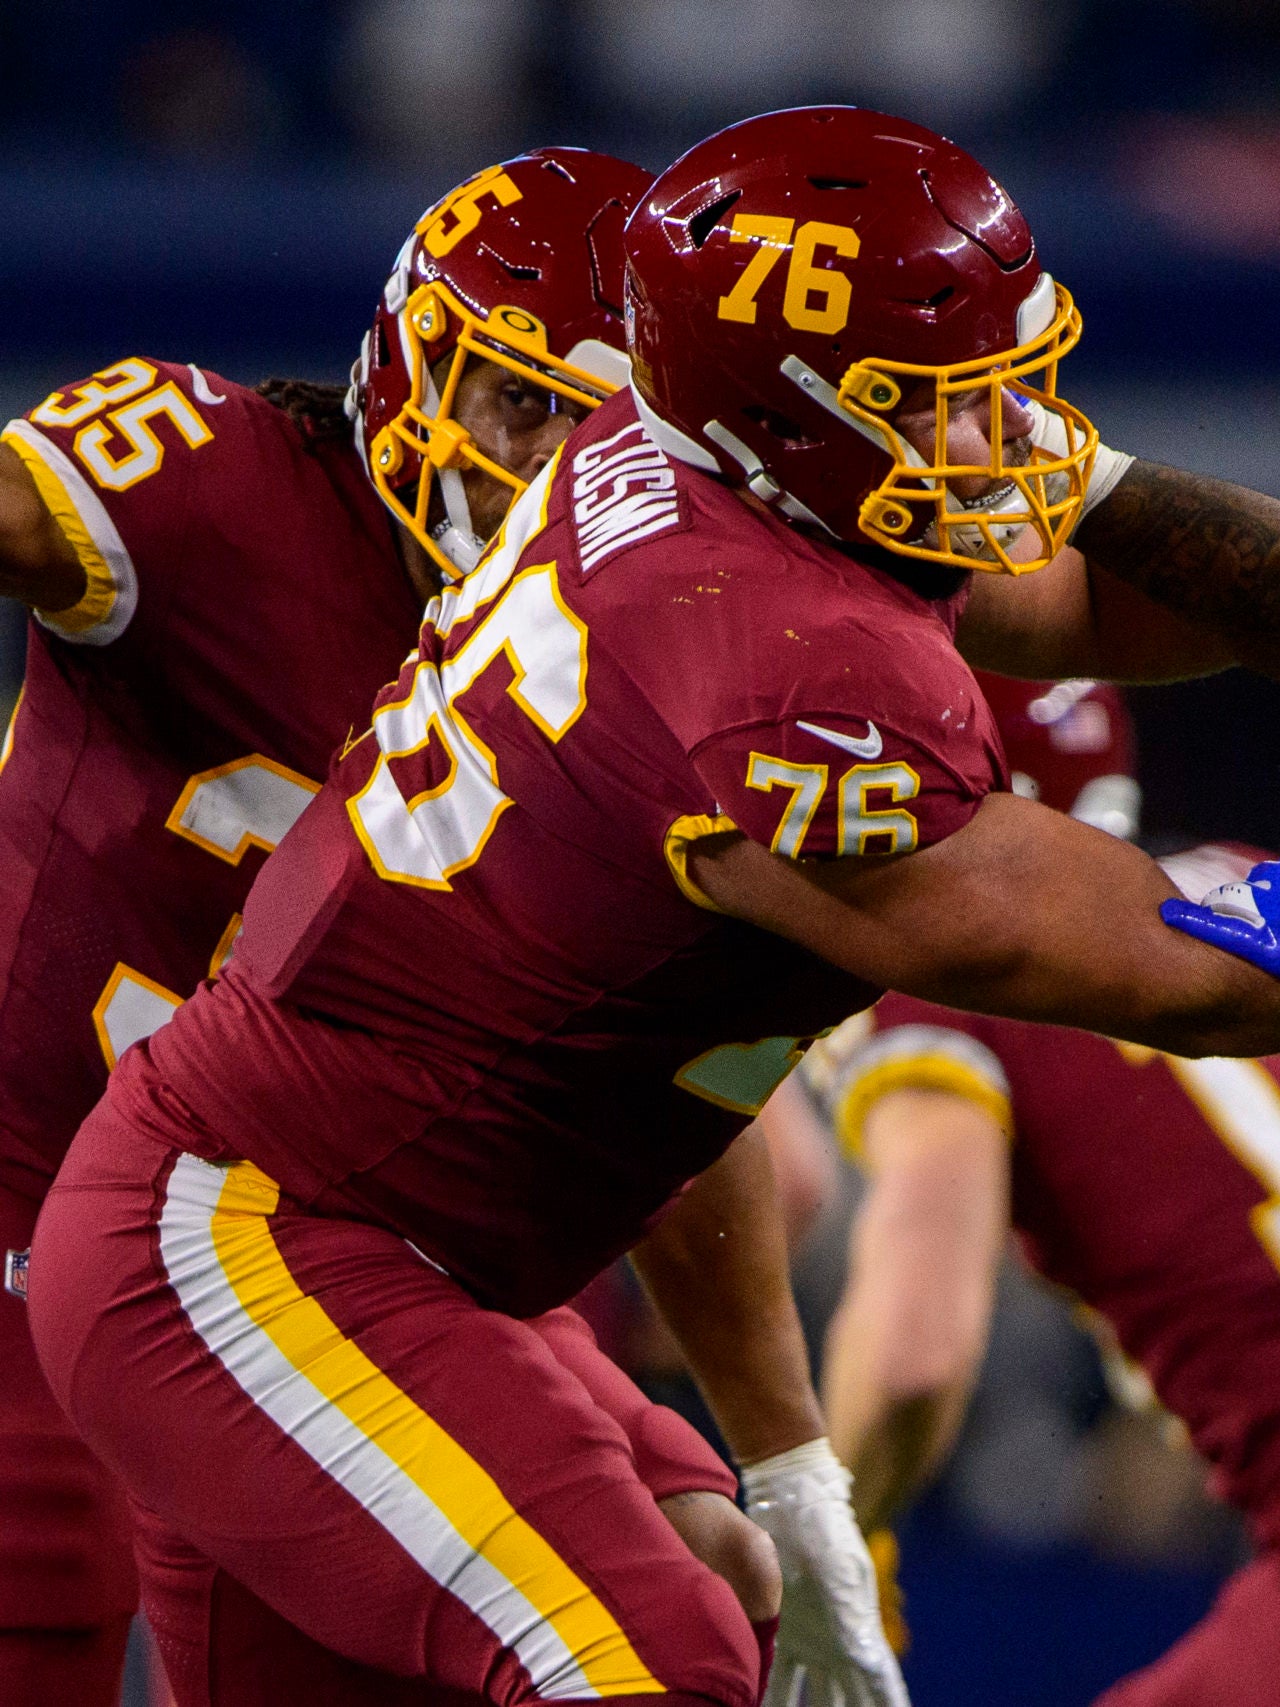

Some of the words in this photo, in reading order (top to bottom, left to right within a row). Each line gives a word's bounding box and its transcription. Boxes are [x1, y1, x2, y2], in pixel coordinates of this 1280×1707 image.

[717, 213, 861, 336] 76
[29, 356, 216, 492] 35
[573, 420, 680, 573] COSMI
[745, 751, 921, 860] 76
